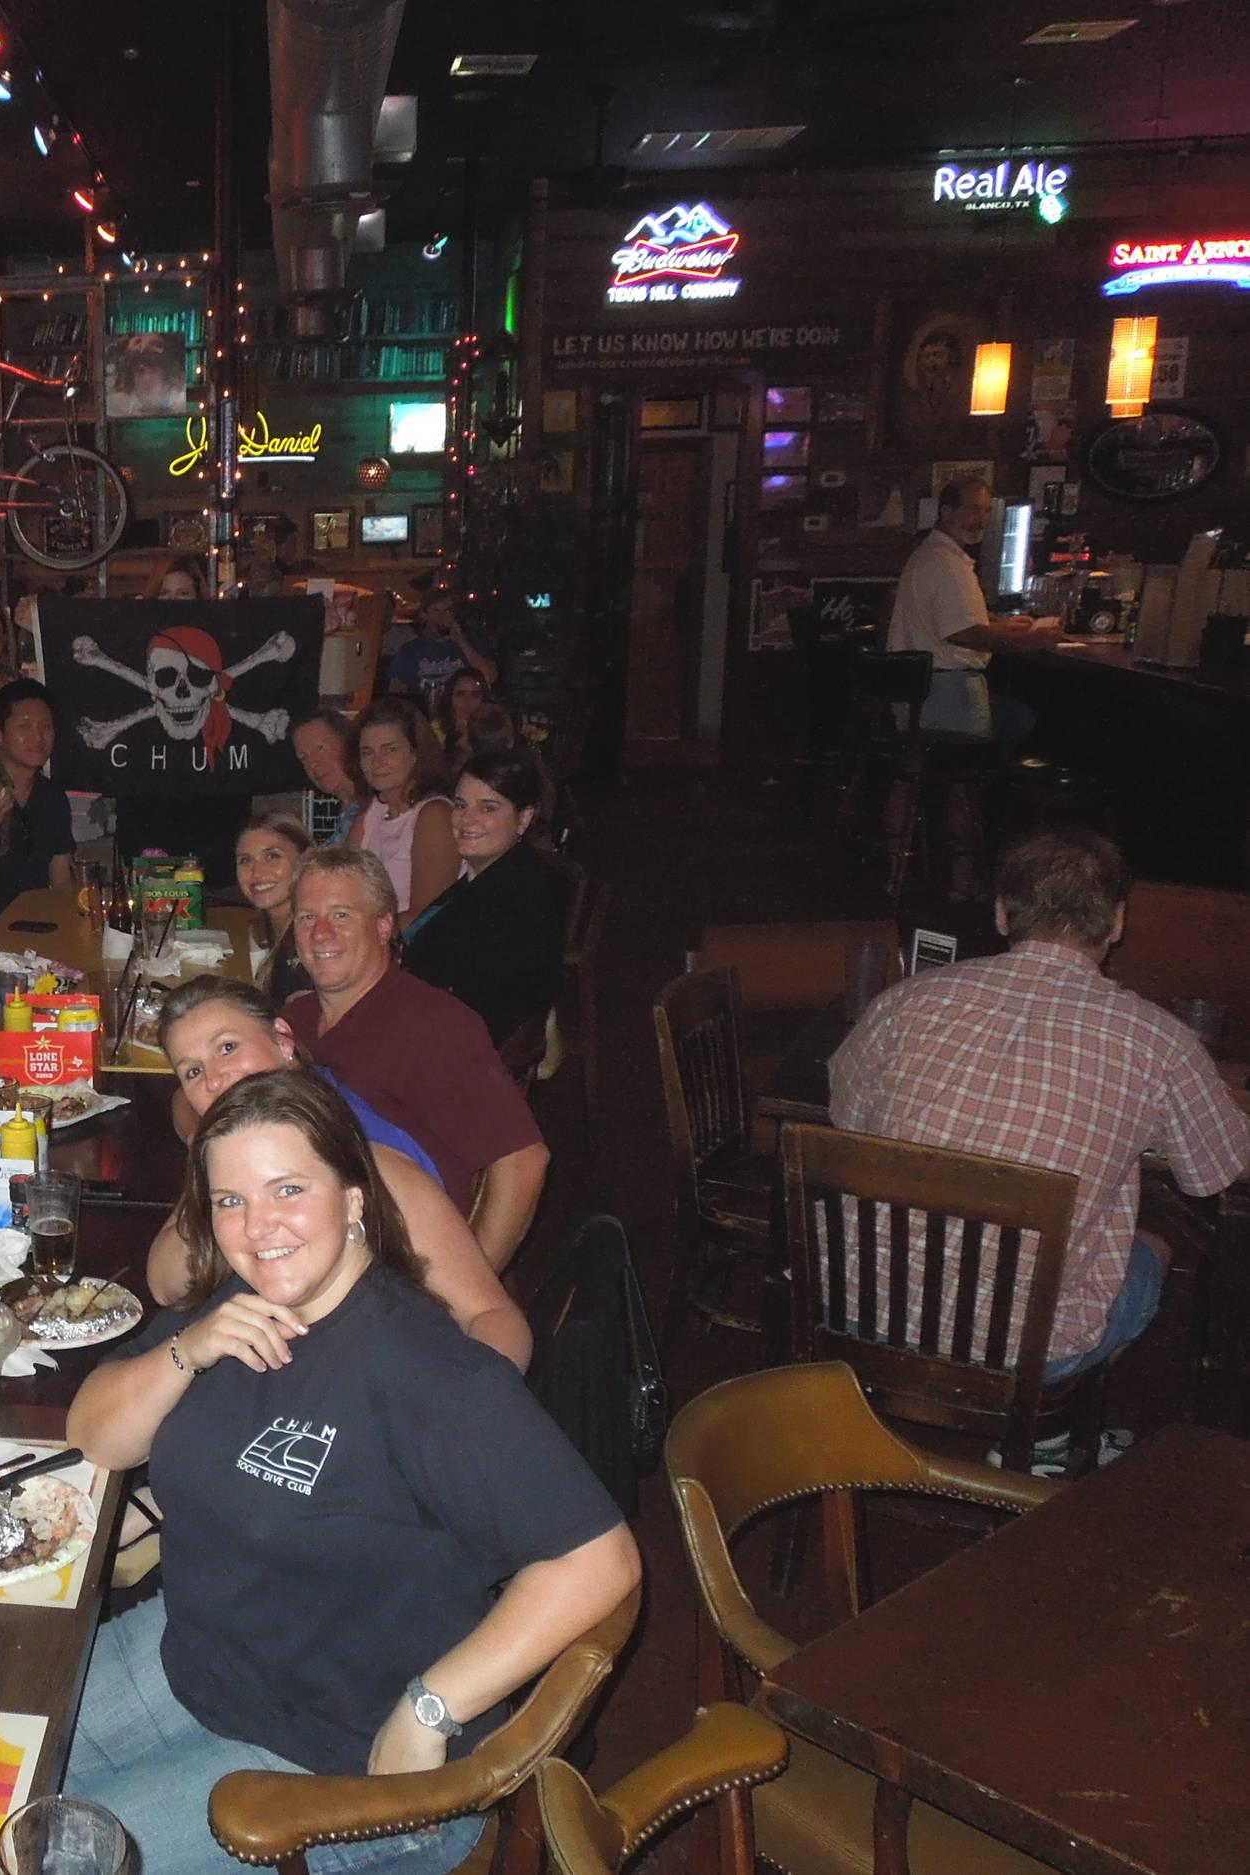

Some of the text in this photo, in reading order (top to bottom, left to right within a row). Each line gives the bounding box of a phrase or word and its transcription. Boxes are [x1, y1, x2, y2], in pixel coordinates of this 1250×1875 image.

[933, 162, 1068, 202] Real Ale
[610, 246, 735, 274] Budweiser
[1112, 243, 1184, 266] SAINT
[606, 285, 649, 303] TEXAS
[649, 284, 679, 302] HILL
[552, 334, 592, 356] LET
[597, 335, 624, 353] US
[632, 331, 689, 353] KNOW
[695, 329, 738, 350] HOW
[741, 325, 793, 349] WE'RE
[28, 1062, 60, 1073] STAR
[29, 1052, 59, 1063] LONE
[235, 1458, 313, 1497] SOCIAL DIVE CLUB
